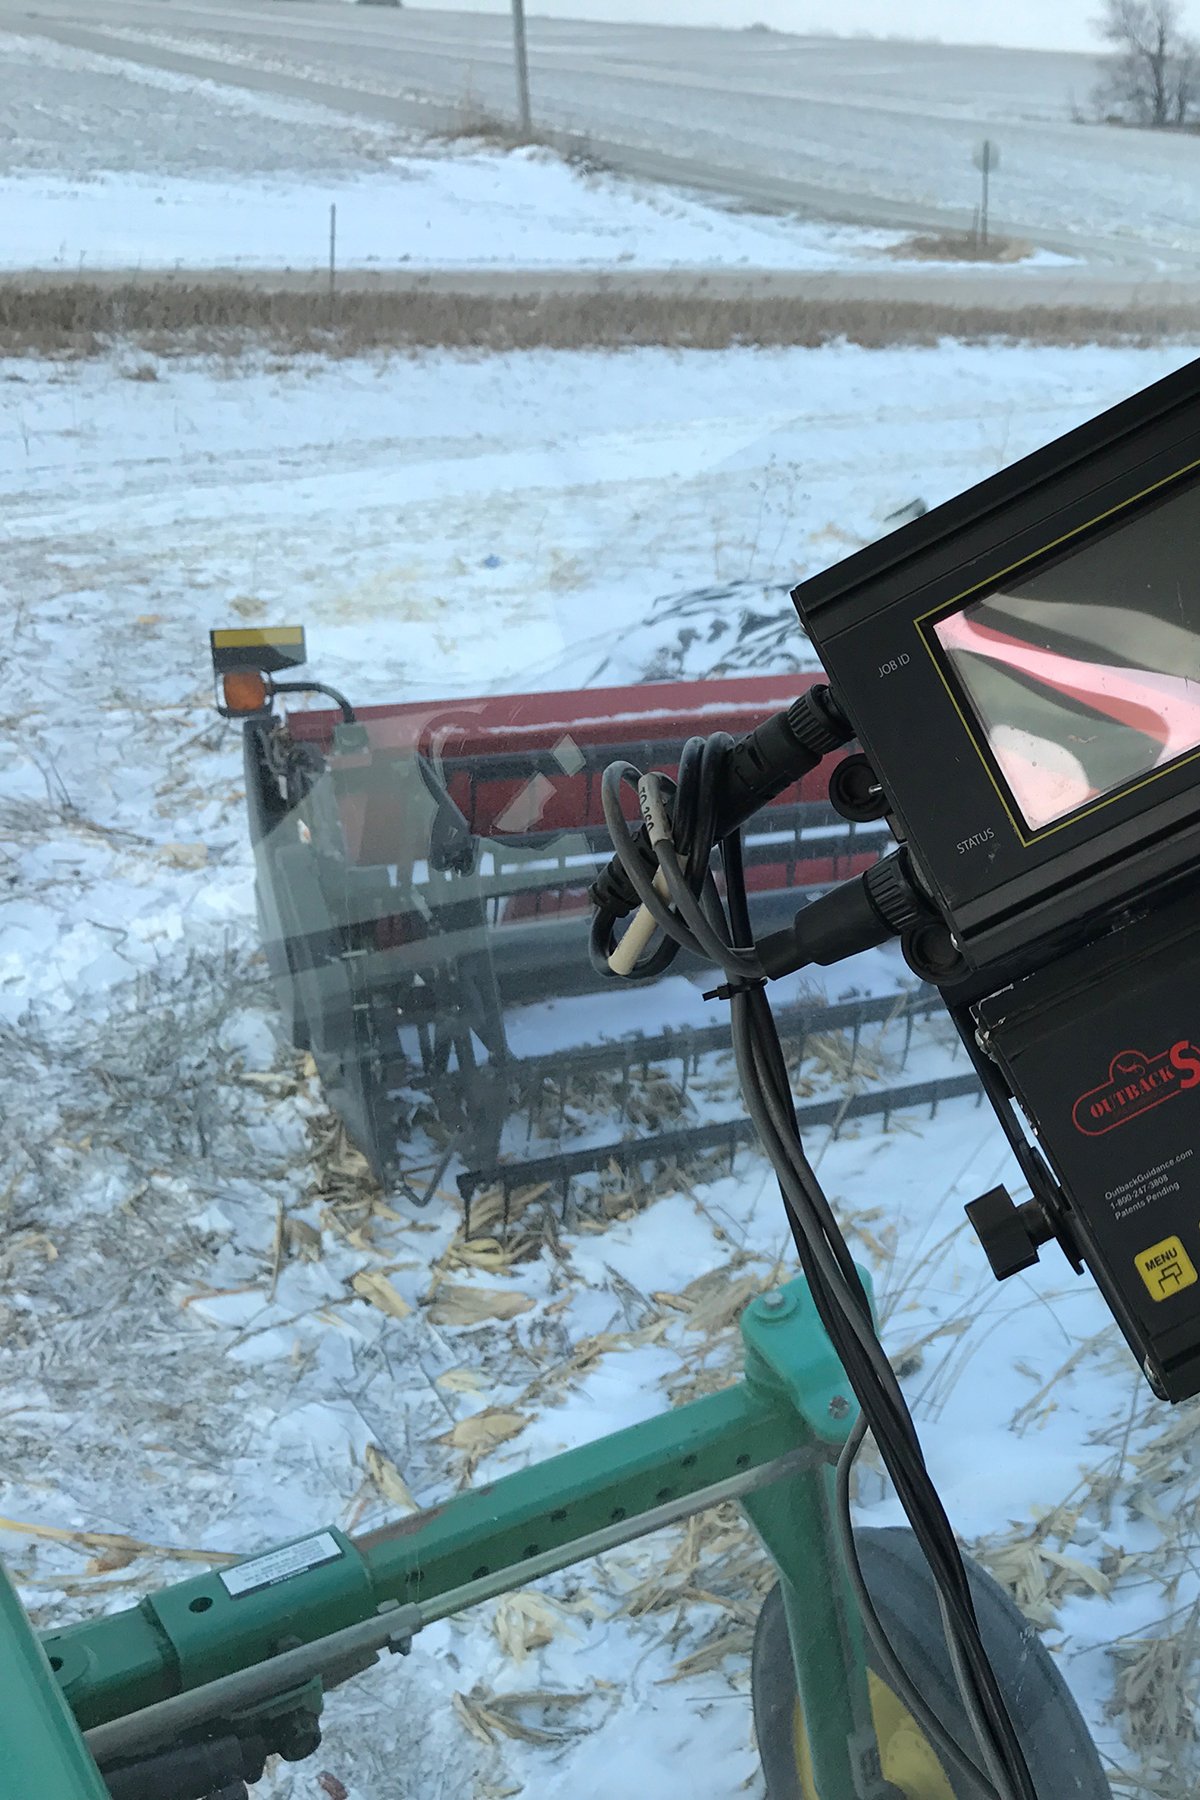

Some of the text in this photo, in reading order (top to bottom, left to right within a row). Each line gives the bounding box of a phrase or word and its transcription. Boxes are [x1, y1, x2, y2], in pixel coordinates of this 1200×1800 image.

[878, 653, 911, 678] JOB ID
[956, 827, 995, 854] STATUS
[1090, 1065, 1176, 1119] OUTBACK
[1104, 1148, 1194, 1200] OutbackGuidance.com
[1115, 1181, 1181, 1221] Patents Pending
[1145, 1247, 1178, 1272] MENU
